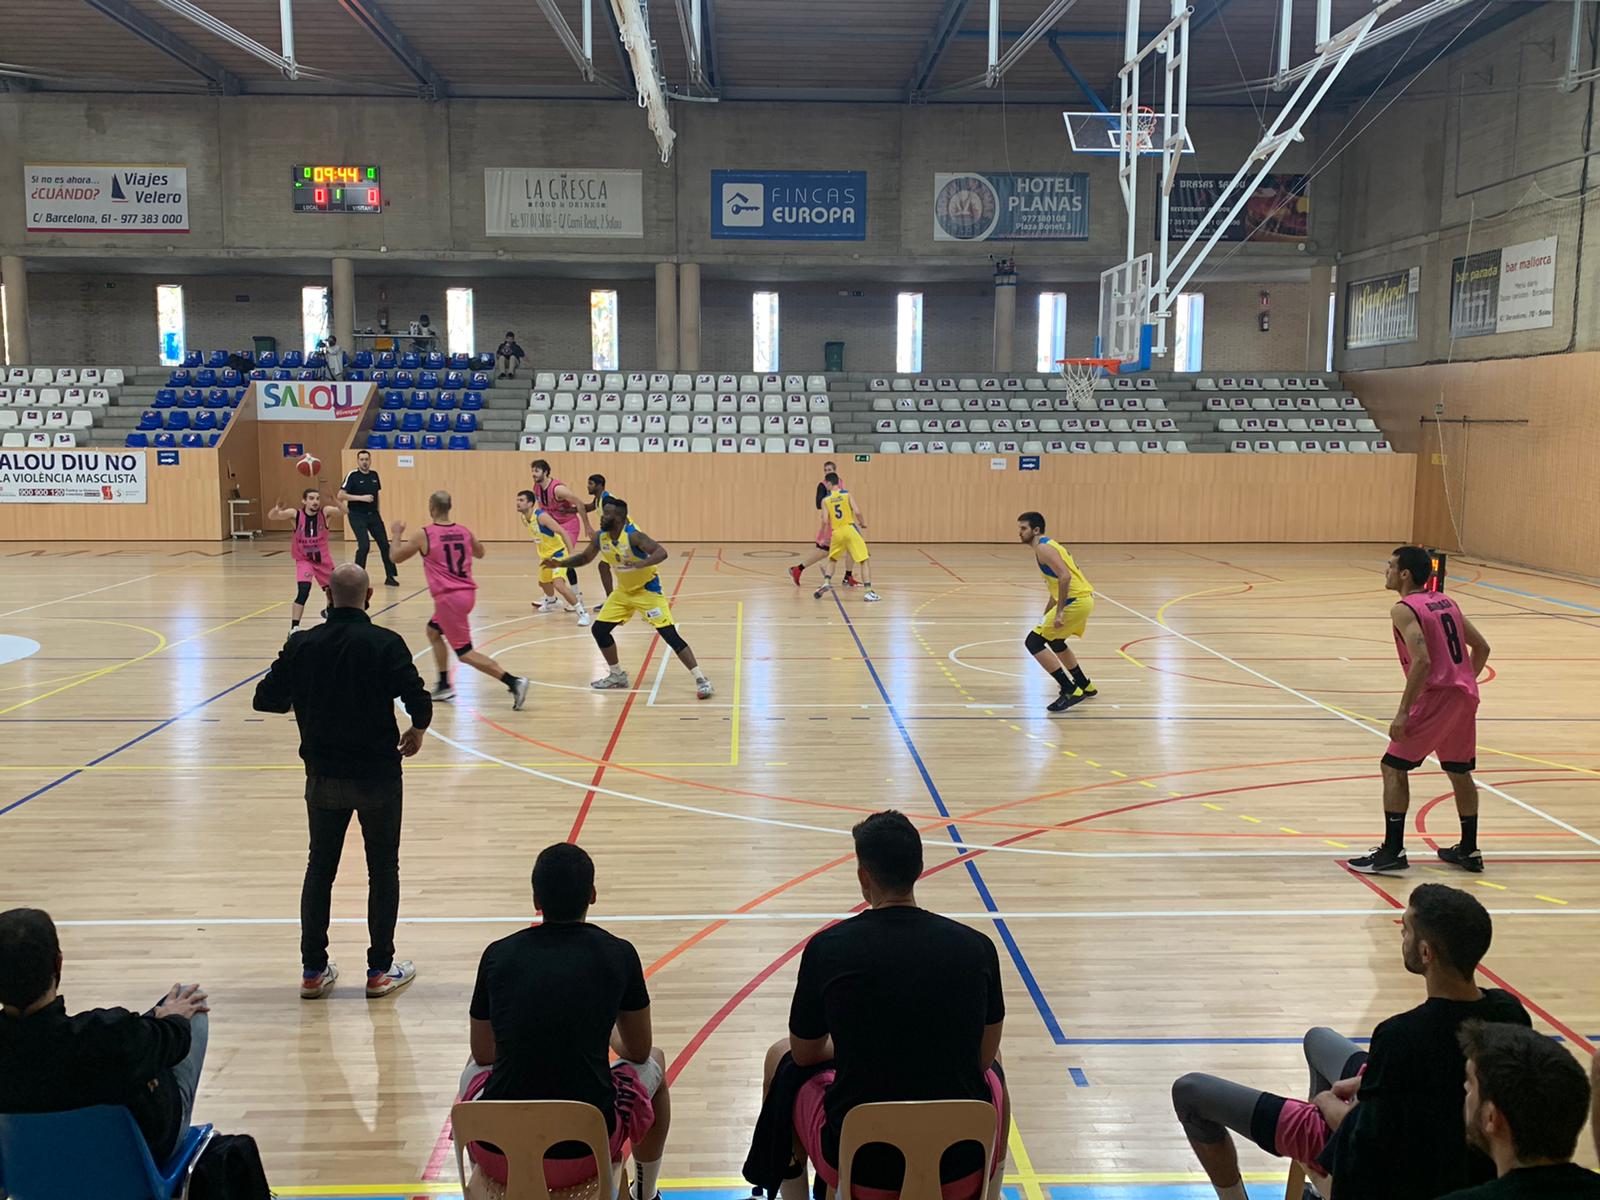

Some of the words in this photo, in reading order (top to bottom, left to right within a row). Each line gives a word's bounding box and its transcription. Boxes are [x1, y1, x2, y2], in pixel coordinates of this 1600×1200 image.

[124, 172, 168, 188] Viajes
[313, 167, 358, 183] 09:44
[525, 178, 543, 200] LA
[548, 176, 608, 200] GRESCA
[1016, 178, 1075, 193] HOTEL
[1180, 180, 1214, 188] BRASAS
[31, 185, 100, 201] ¿CUÁNDO?
[136, 190, 182, 204] Velero
[772, 188, 856, 204] FINCAS
[1008, 196, 1082, 212] PLANAS
[33, 213, 44, 224] C/
[46, 213, 98, 225] Barcelona,
[101, 214, 112, 224] 61
[121, 214, 138, 224] 977
[140, 214, 159, 224] 383
[162, 214, 183, 224] 000
[772, 206, 856, 224] EUROPA
[1038, 223, 1065, 231] Bonet,
[1506, 261, 1518, 273] bar
[1519, 255, 1552, 270] mallorca
[264, 383, 353, 410] SALOU
[62, 454, 99, 471] DIU
[106, 454, 136, 471] NO
[14, 472, 73, 483] VIOLÈNCIA
[76, 474, 138, 484] MASCLISTA
[34, 488, 48, 496] 900
[50, 488, 64, 496] 120
[834, 504, 843, 519] 5
[443, 543, 468, 579] 12
[1440, 613, 1462, 664] 8
